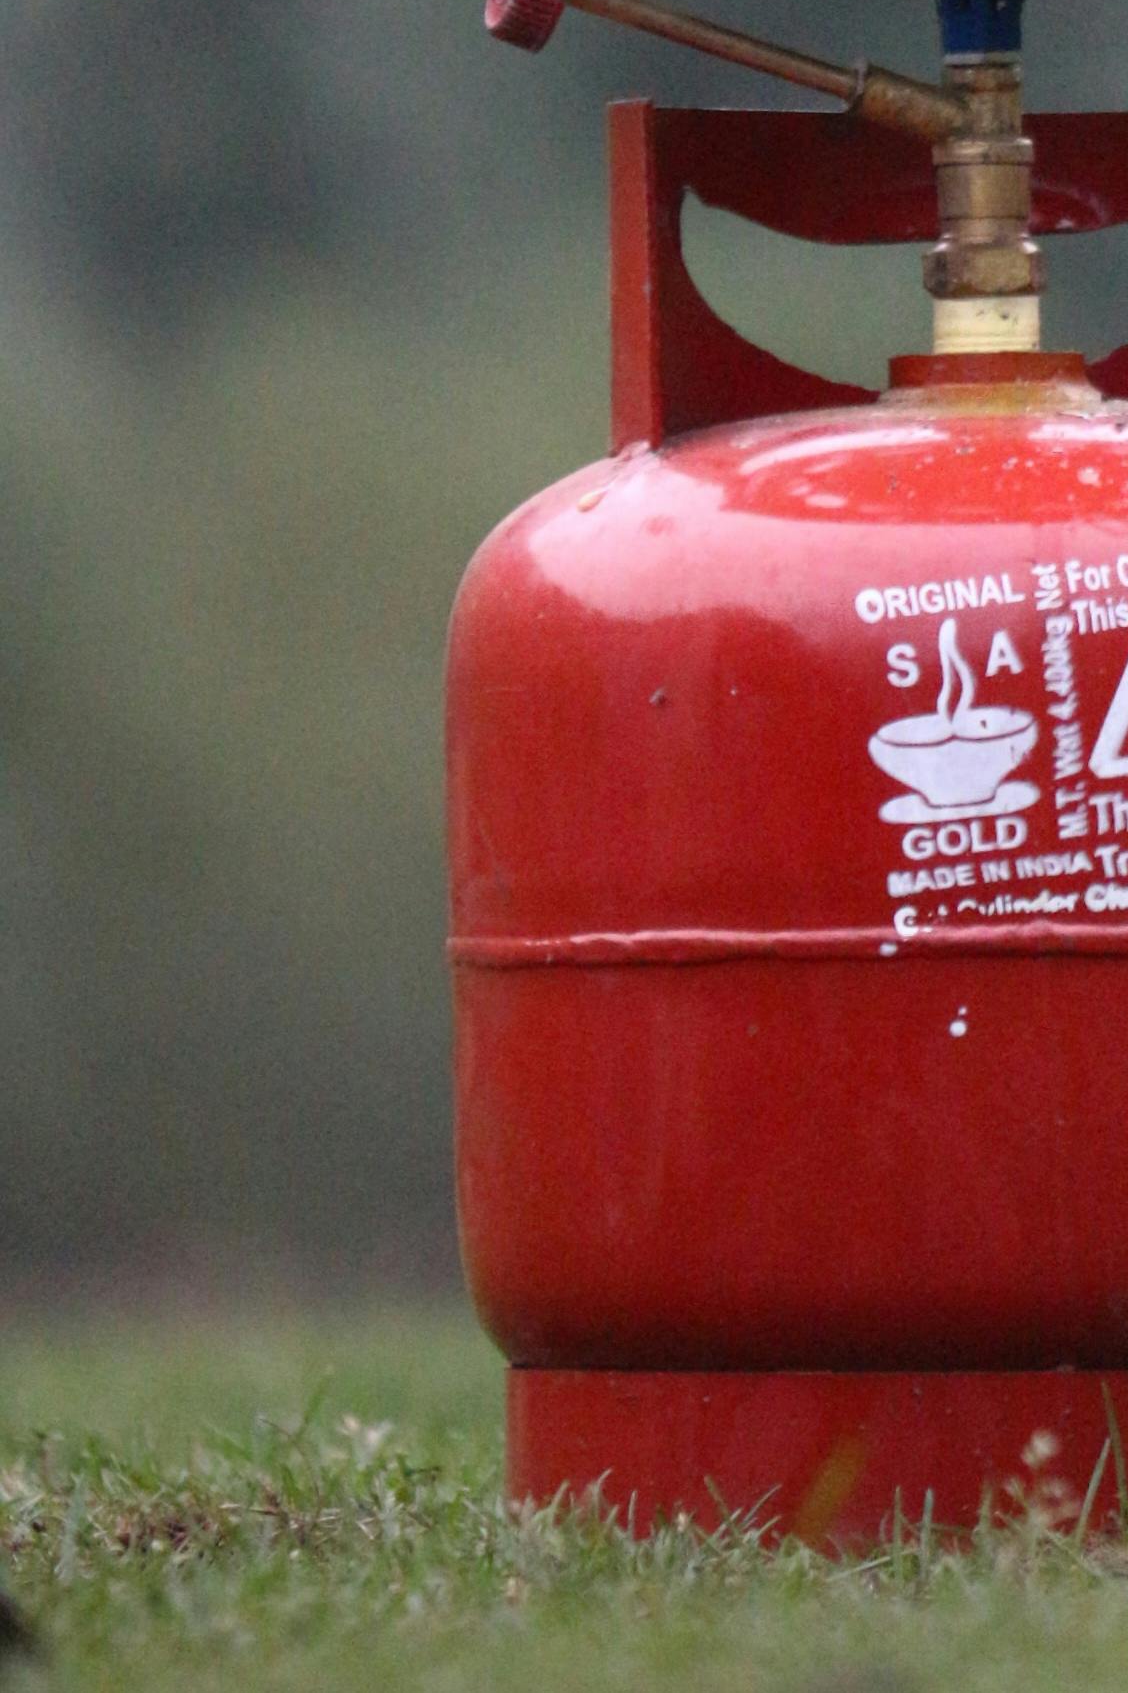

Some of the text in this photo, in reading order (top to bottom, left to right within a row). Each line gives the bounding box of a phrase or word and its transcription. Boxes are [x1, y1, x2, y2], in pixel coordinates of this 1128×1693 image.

[855, 572, 1026, 624] ORIGINAL
[1031, 563, 1063, 611] Net
[1065, 559, 1110, 594] For
[886, 629, 1024, 688] S A
[902, 816, 1028, 860] GOLD
[887, 851, 1093, 897] MADE IN INDIA
